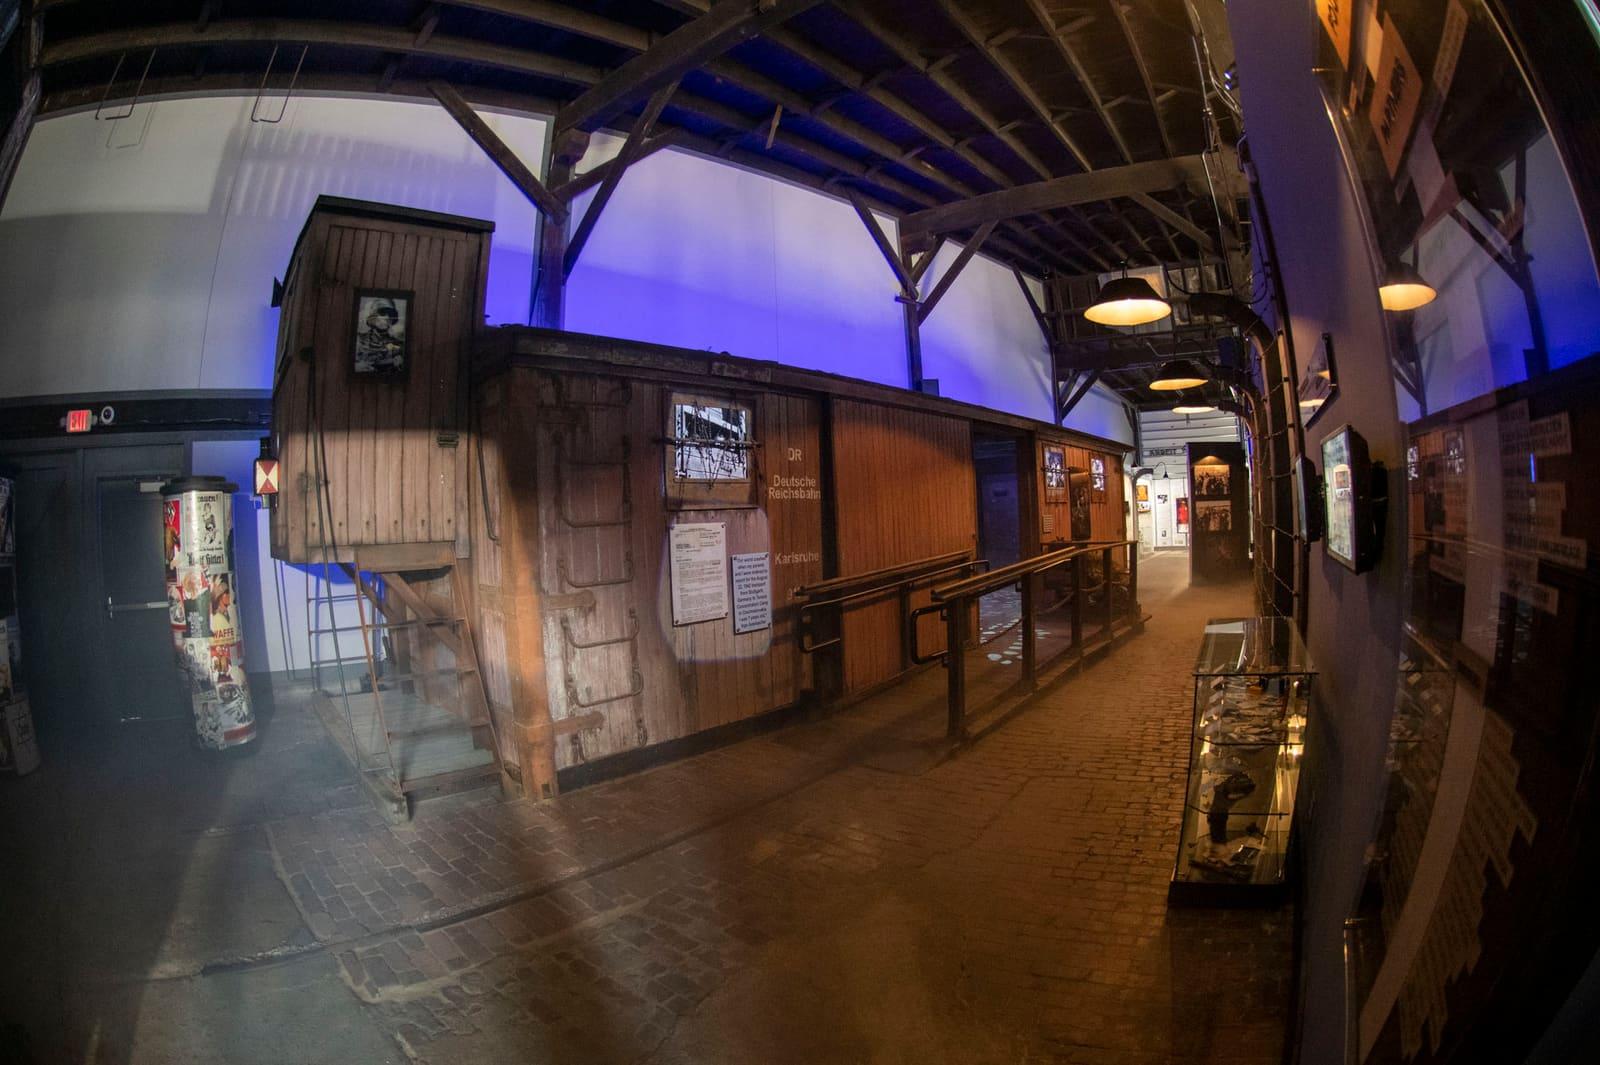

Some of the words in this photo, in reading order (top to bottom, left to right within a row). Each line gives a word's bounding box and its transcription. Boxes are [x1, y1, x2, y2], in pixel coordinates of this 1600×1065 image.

[788, 447, 802, 461] DR
[773, 474, 816, 487] Deutsche
[768, 487, 821, 500] Reichsbahn
[774, 551, 819, 565] Karlsruhe
